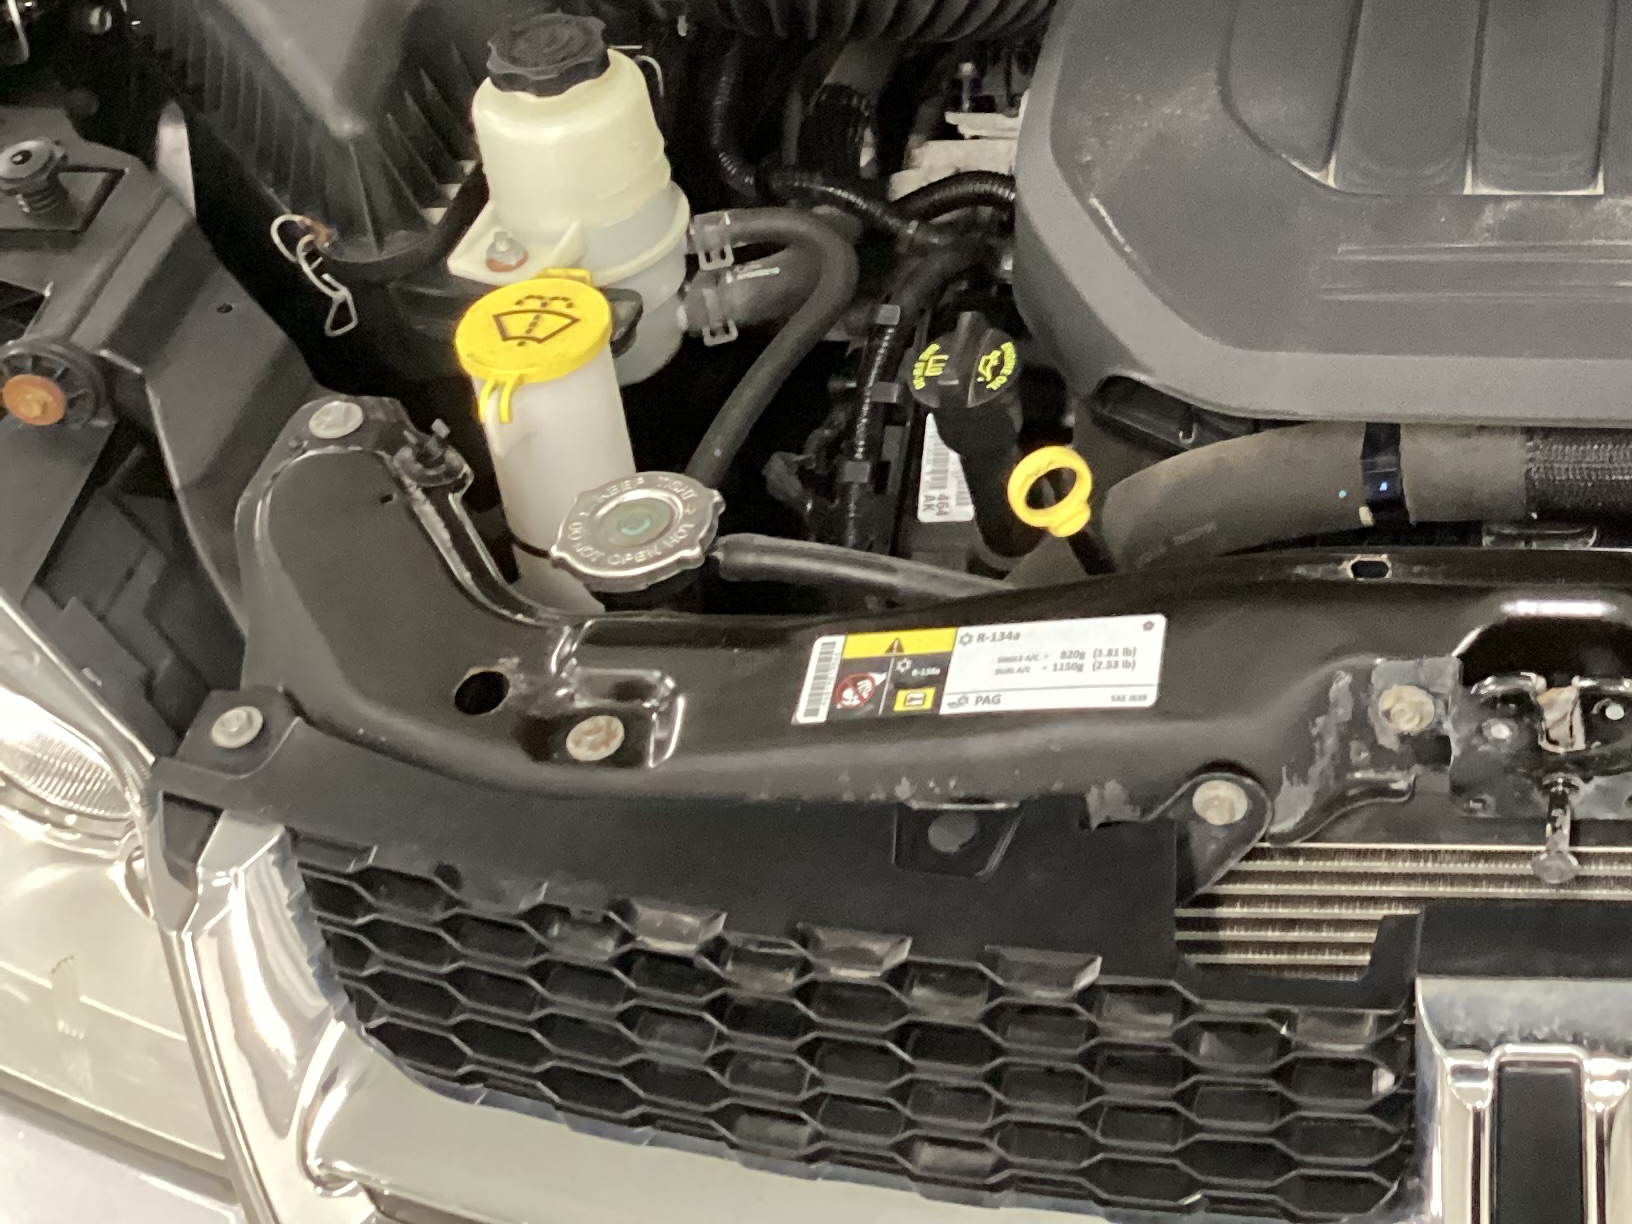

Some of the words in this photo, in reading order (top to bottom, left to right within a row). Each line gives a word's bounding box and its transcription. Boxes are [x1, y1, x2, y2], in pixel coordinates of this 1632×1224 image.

[986, 375, 1007, 390] OIL
[657, 476, 698, 500] TIGHT
[922, 495, 936, 511] AK
[936, 494, 949, 516] 464
[608, 546, 662, 565] OPEN
[976, 631, 1021, 643] R-134a
[1060, 650, 1086, 661] 820g
[1122, 647, 1137, 657] lb)
[1121, 659, 1136, 670] lb)
[974, 694, 1002, 706] PAG
